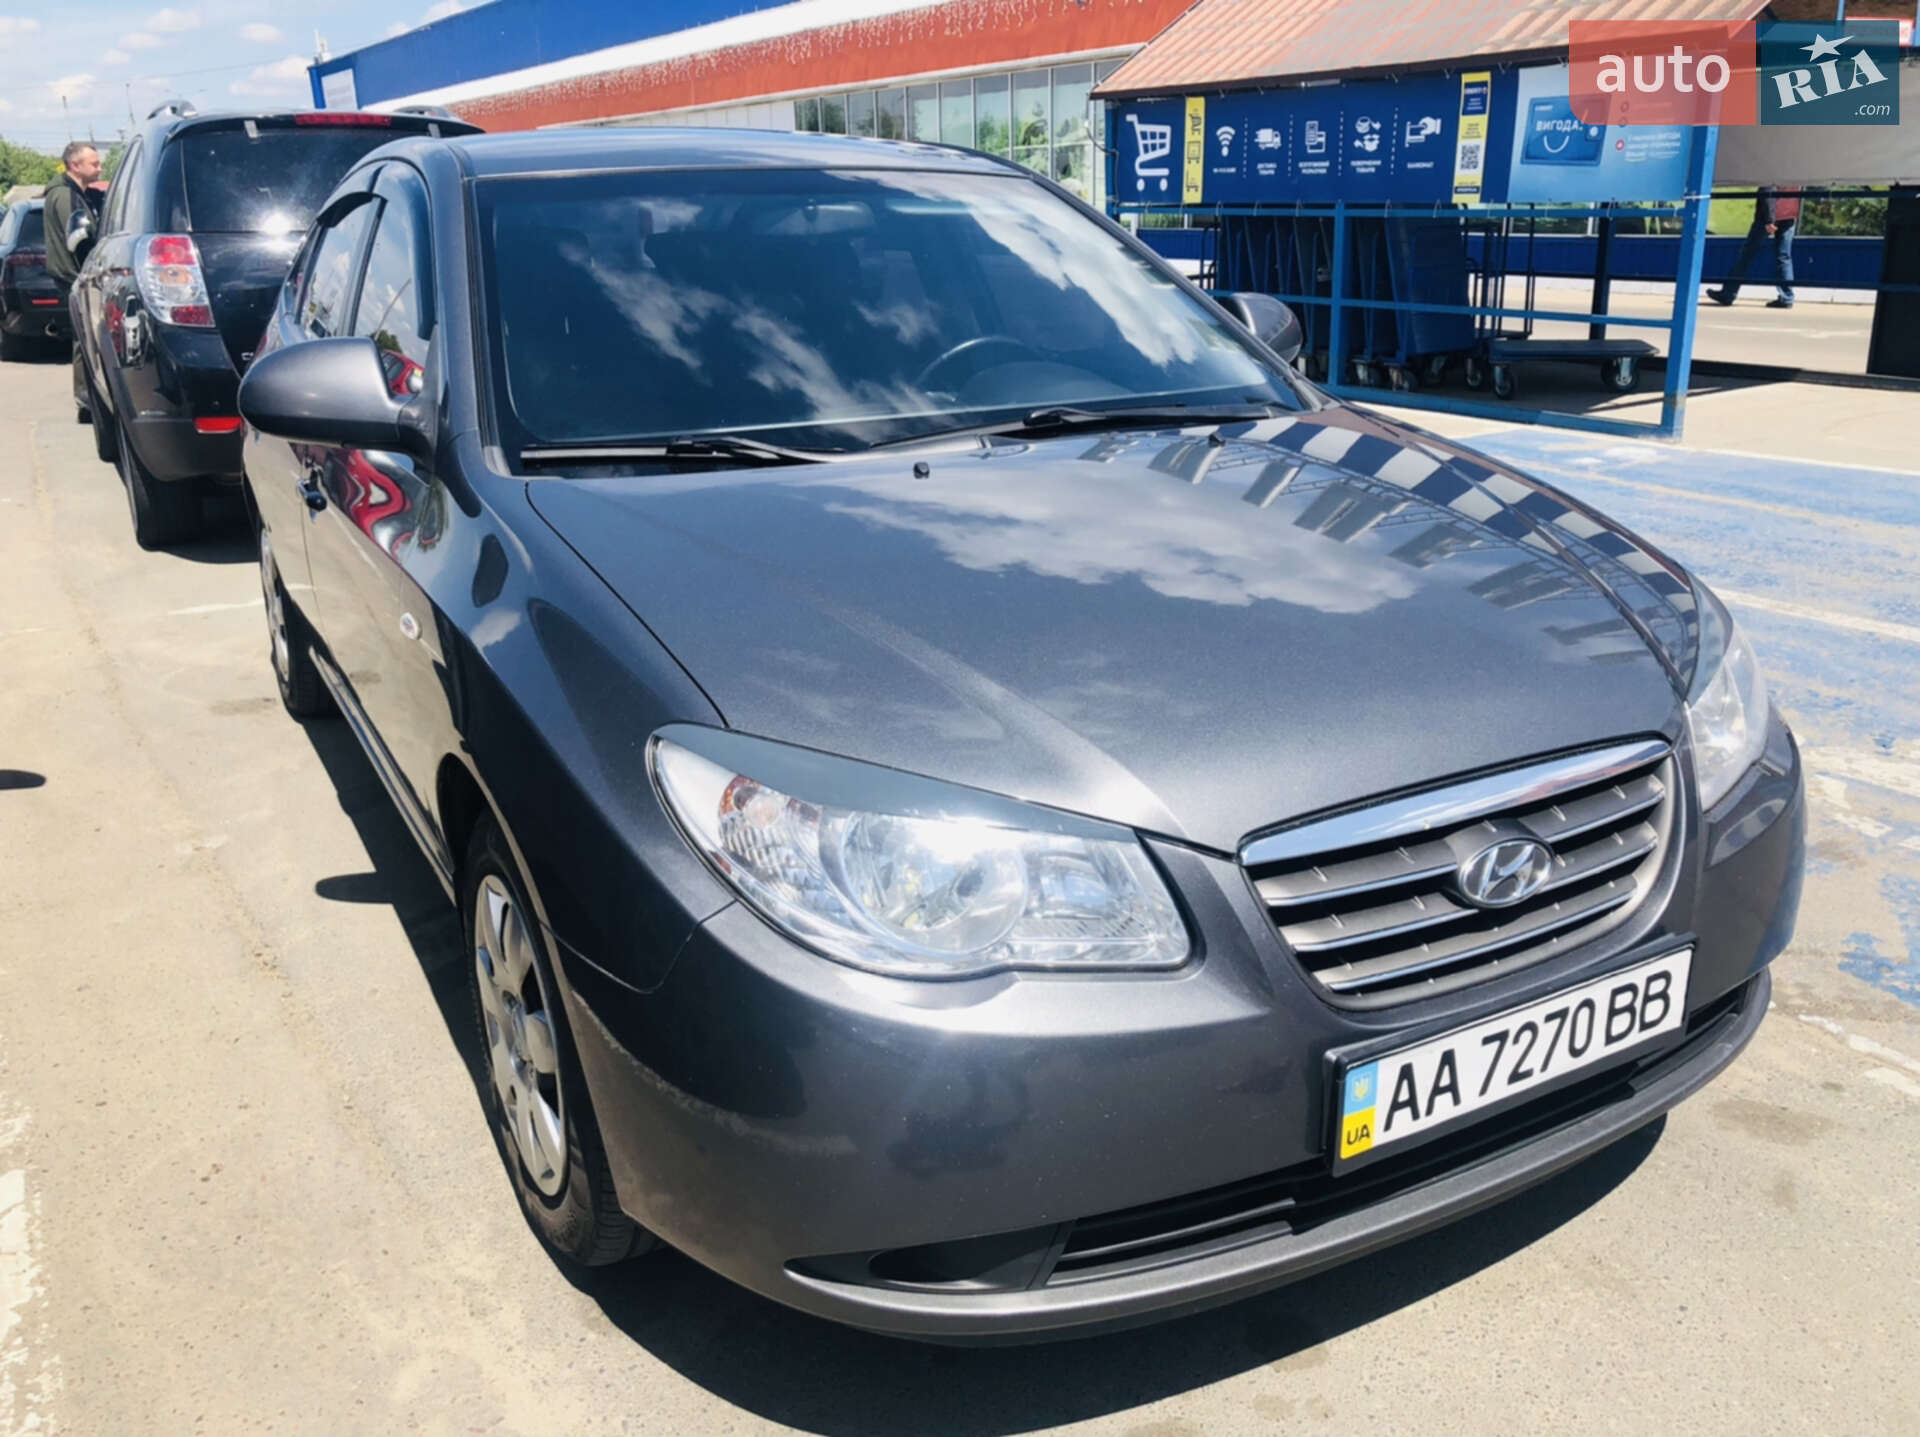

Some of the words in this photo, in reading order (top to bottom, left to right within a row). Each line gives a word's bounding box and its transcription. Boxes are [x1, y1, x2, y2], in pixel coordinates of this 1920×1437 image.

[1383, 1048, 1462, 1132] AA
[1478, 997, 1596, 1097] 7270
[1604, 970, 1673, 1046] BB
[1346, 1123, 1371, 1145] UA
